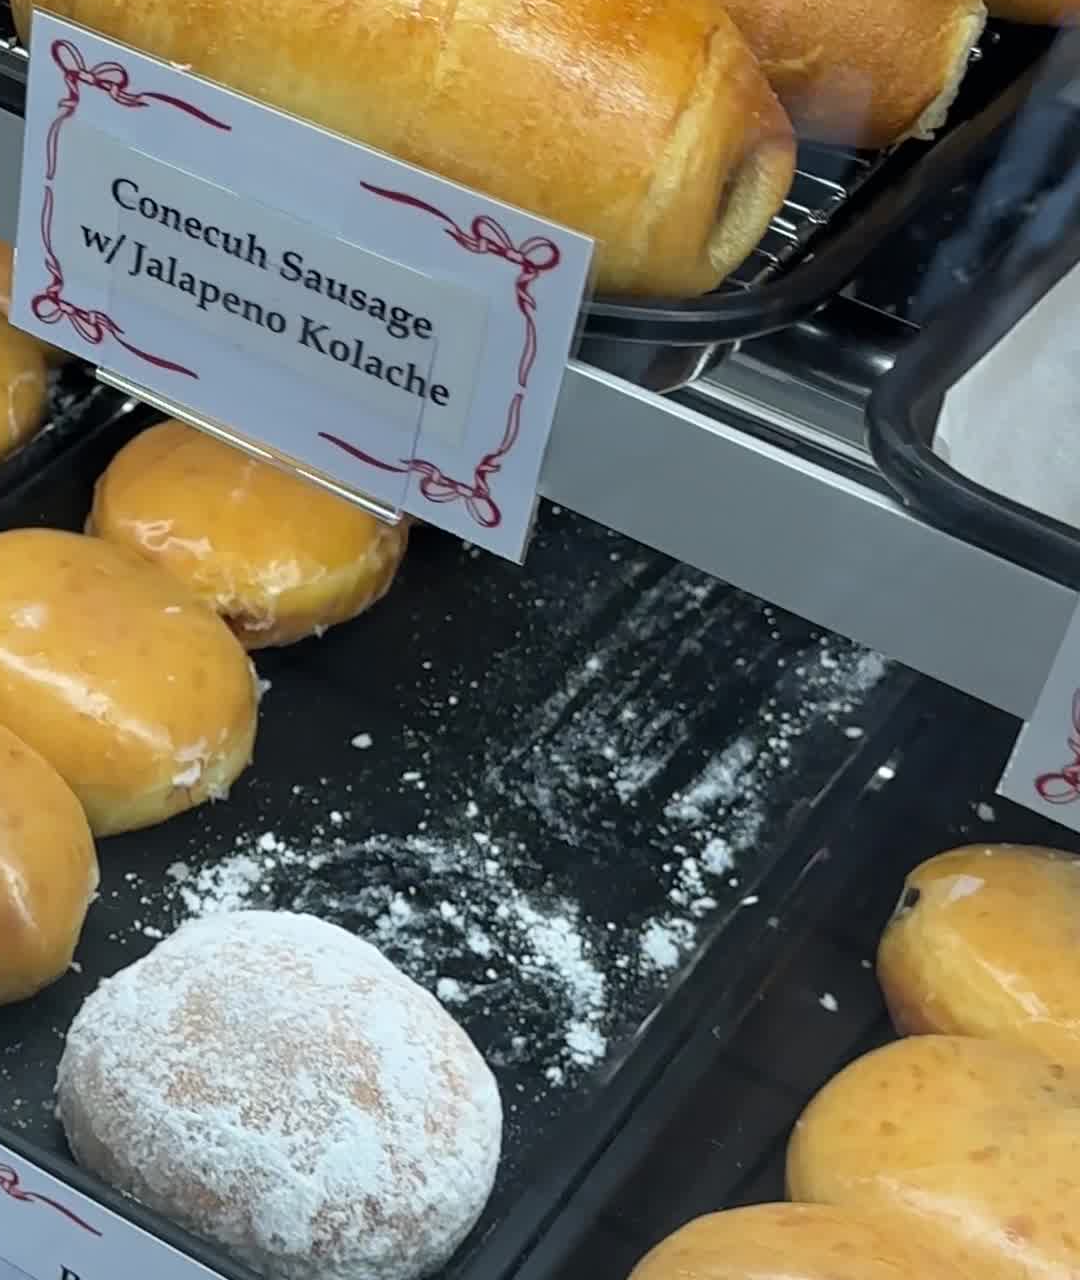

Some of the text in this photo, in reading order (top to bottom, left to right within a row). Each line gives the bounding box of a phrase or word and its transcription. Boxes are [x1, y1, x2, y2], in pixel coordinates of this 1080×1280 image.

[80, 222, 451, 407] w/ Jalapeno Kolache
[110, 176, 433, 340] Conecuh Sausage
